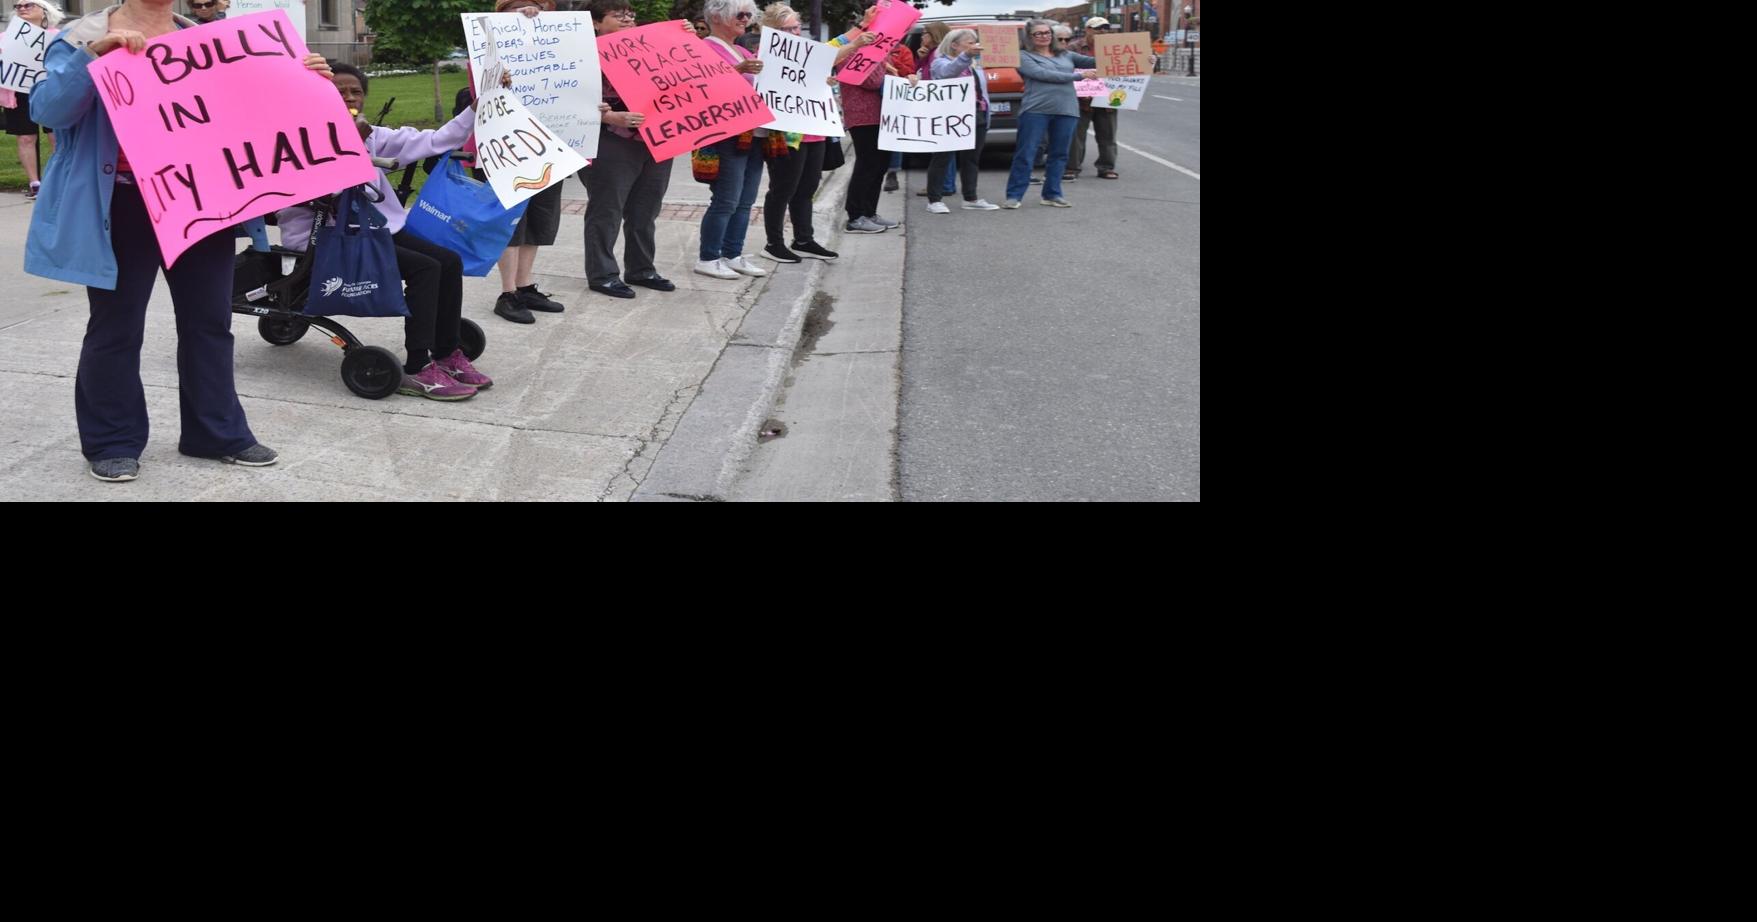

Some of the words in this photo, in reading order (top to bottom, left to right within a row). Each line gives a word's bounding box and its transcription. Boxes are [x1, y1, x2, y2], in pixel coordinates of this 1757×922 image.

[533, 17, 582, 33] Honest
[472, 38, 524, 52] LEDERS
[532, 36, 560, 46] HOLD
[598, 34, 655, 62] WORK
[770, 32, 813, 68] RALLY
[1104, 44, 1142, 56] LEAL
[101, 66, 134, 110] NO
[146, 20, 296, 85] BULLY
[627, 43, 702, 76] PLACE
[1105, 64, 1144, 76] HEEL
[1111, 56, 1120, 65] IS
[1128, 55, 1136, 64] A
[541, 78, 549, 90] 7
[554, 79, 579, 88] WHO
[651, 60, 734, 92] BULLYING
[781, 66, 806, 87] FOR
[494, 95, 514, 117] BE
[653, 84, 708, 113] ISN'T
[158, 95, 211, 132] IN
[645, 94, 763, 147] LEADERSHIP
[881, 114, 974, 137] MATTERS
[478, 117, 563, 178] FIRED!
[141, 163, 203, 223] CITY
[222, 122, 361, 189] HALL
[419, 200, 451, 223] Walmart
